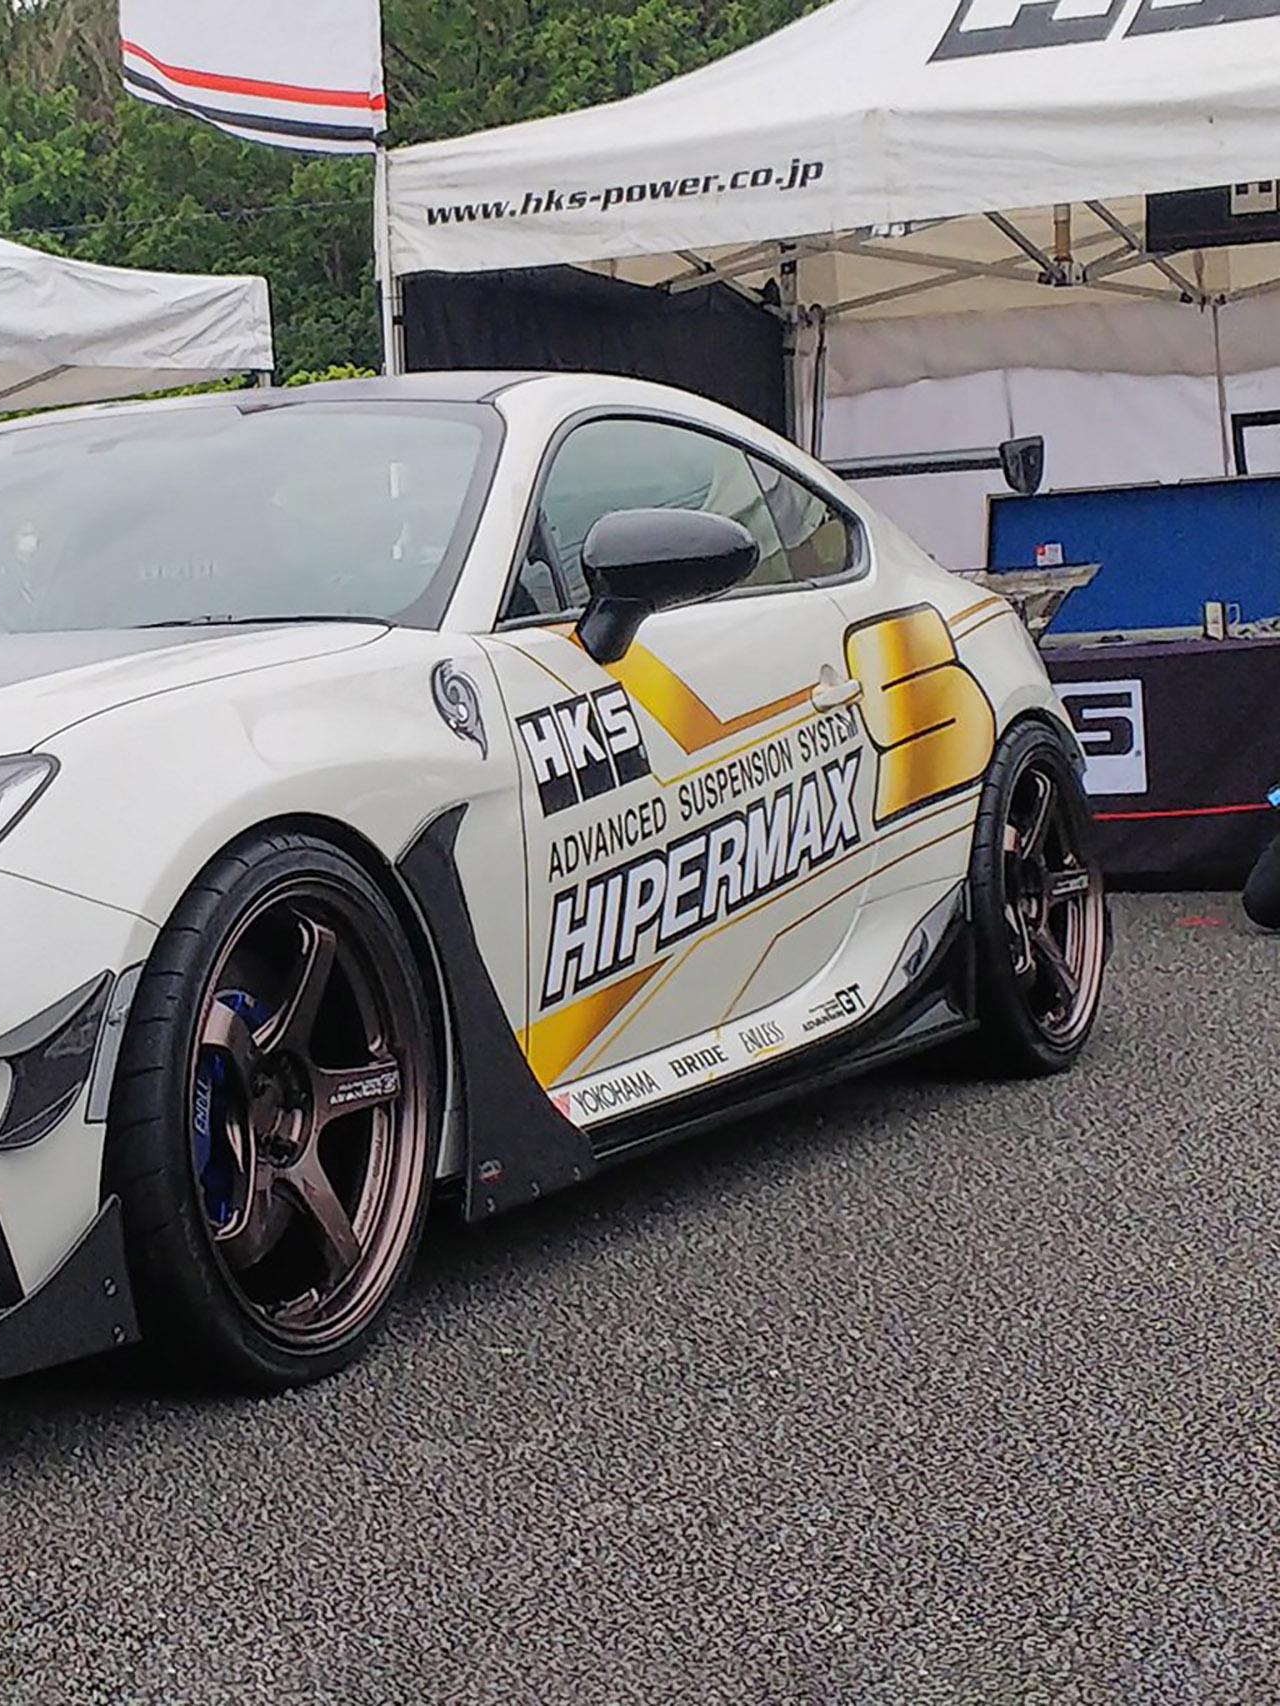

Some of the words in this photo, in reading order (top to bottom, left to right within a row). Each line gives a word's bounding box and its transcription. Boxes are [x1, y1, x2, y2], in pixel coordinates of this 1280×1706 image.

[426, 158, 824, 226] www.hks-power.co.jp
[520, 685, 642, 784] HKS
[549, 797, 667, 882] ADVANCED
[679, 743, 793, 821] SUSPENSION
[797, 703, 859, 763] SYSTEM
[540, 745, 864, 1011] HIPERMAX
[572, 1070, 660, 1116] YOKOHAMA
[669, 1046, 729, 1079] BRIDE
